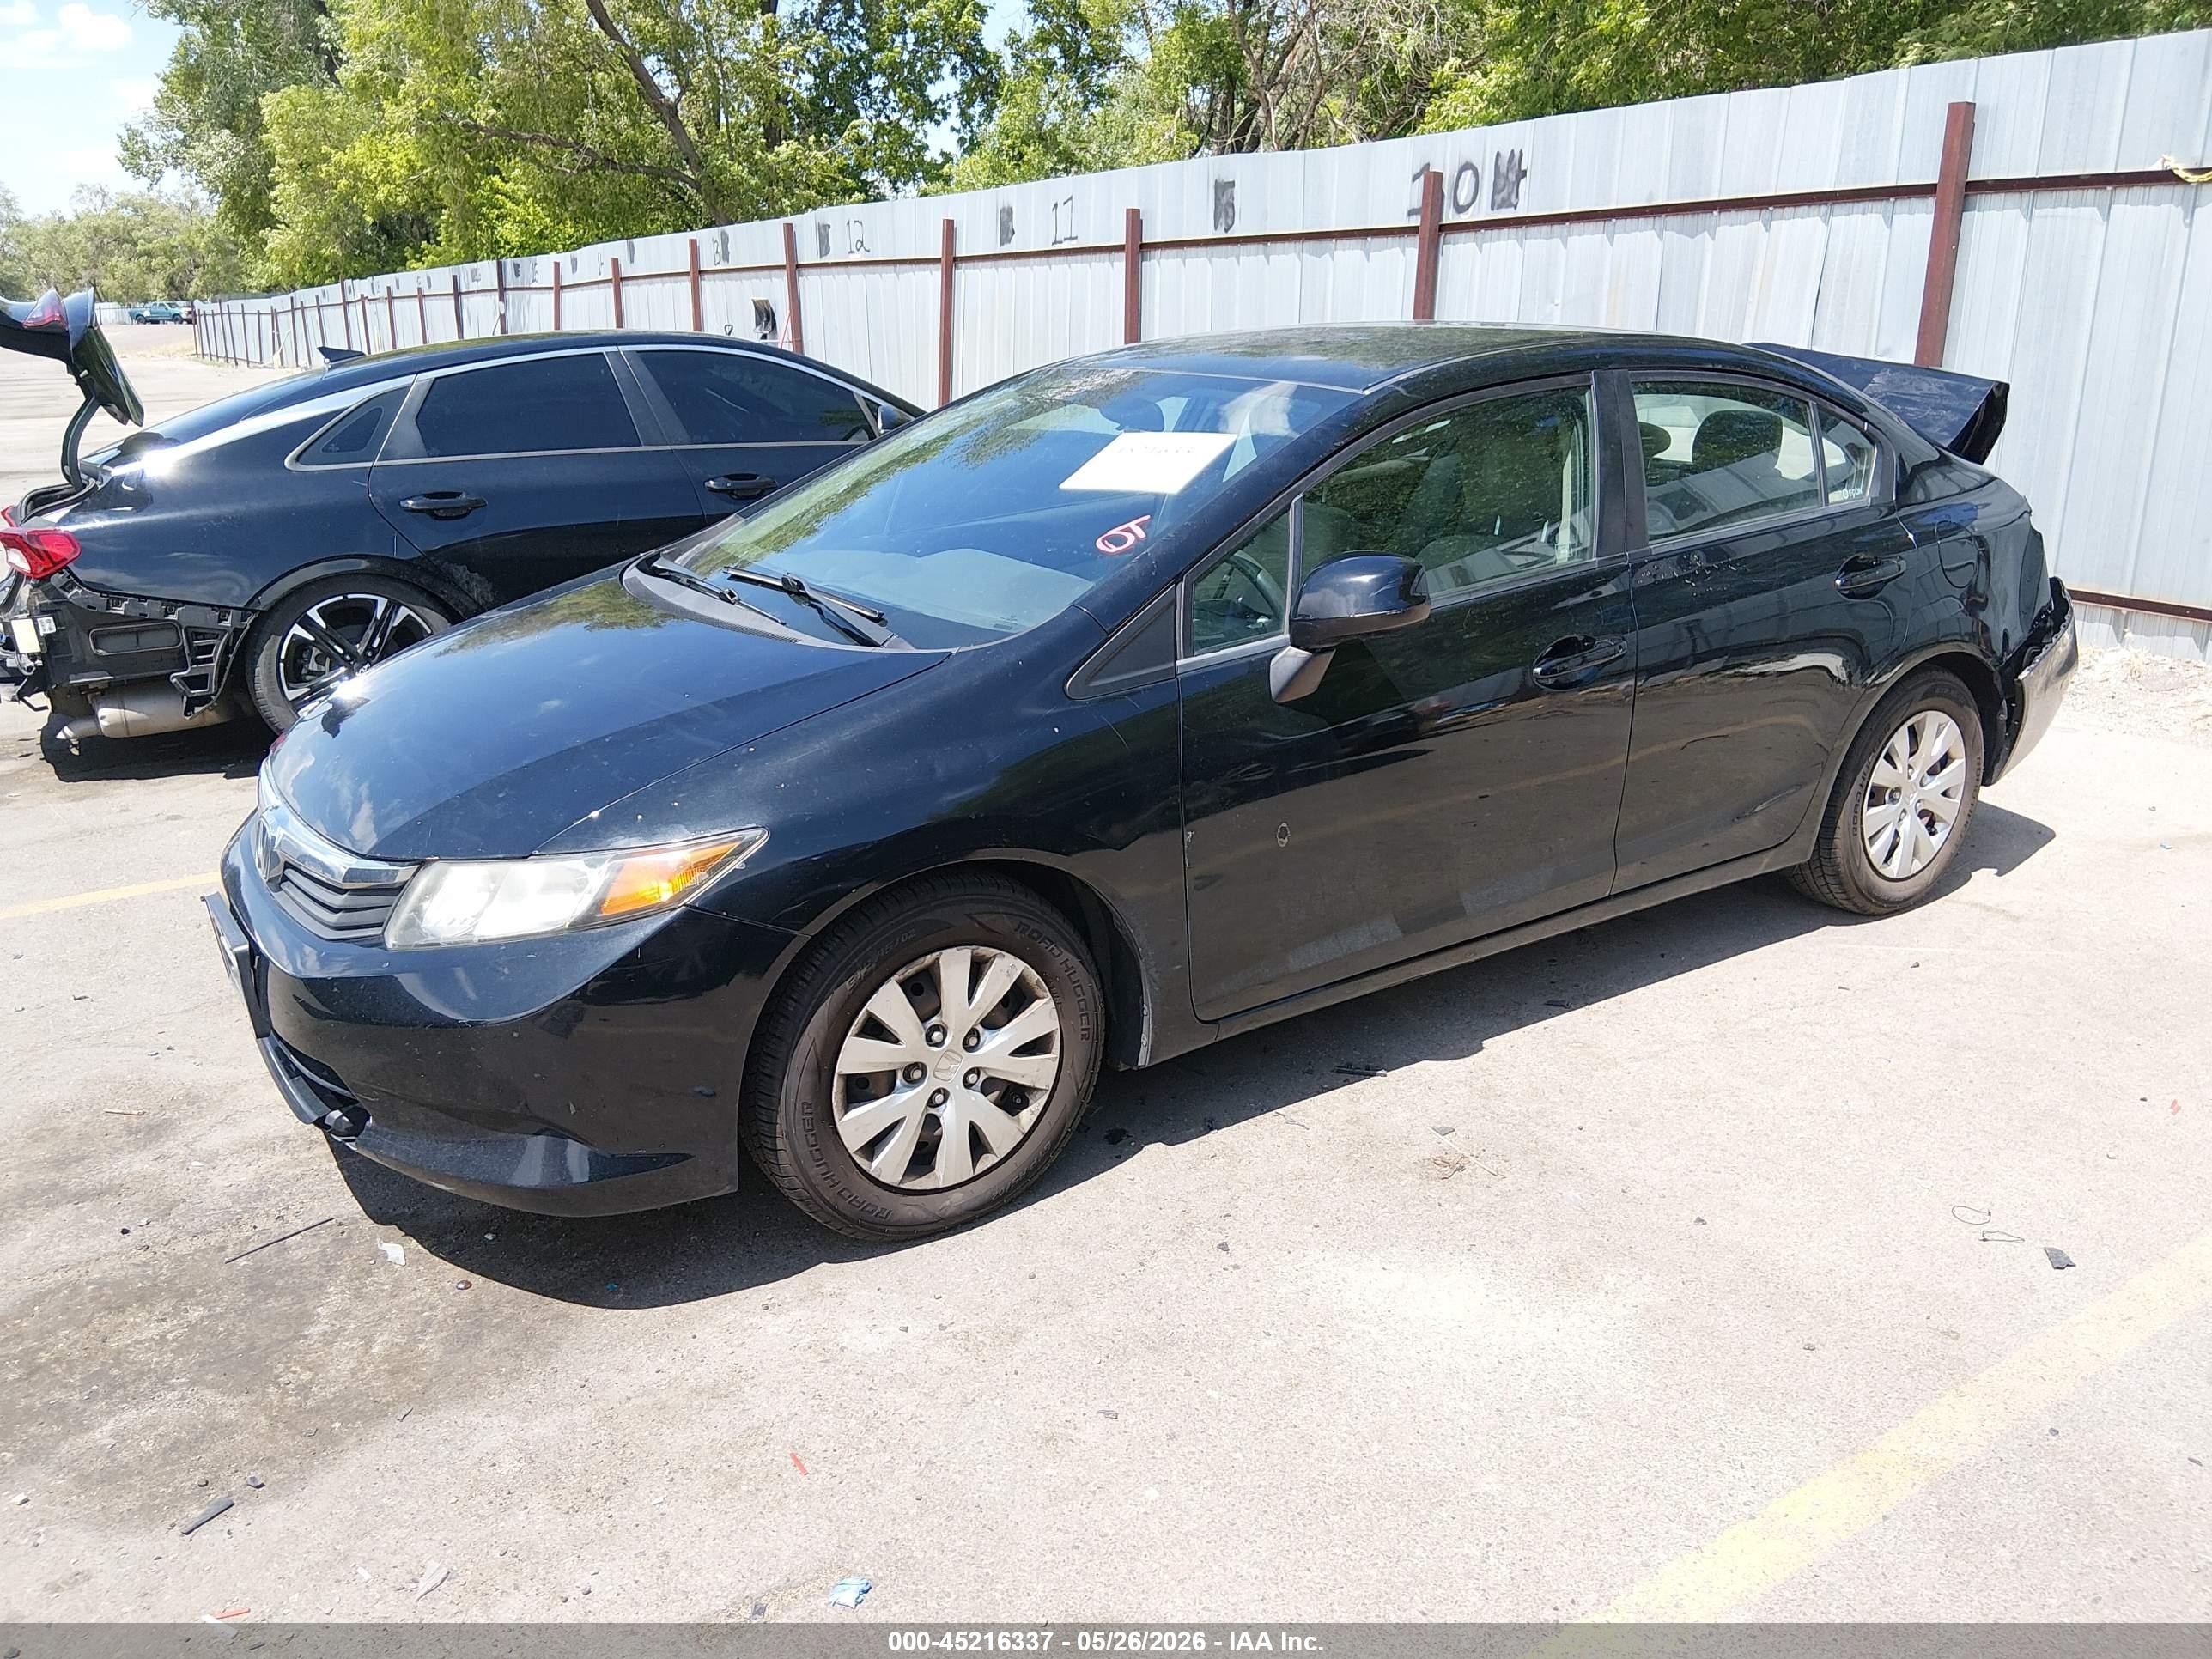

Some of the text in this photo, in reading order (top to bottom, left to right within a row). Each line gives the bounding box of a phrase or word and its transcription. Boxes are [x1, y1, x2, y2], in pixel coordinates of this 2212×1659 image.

[846, 220, 870, 255] 12
[1043, 194, 1079, 246] 11
[1014, 921, 1091, 1042] ROAD HUGGER
[801, 1101, 893, 1219] ROAD HUGGER
